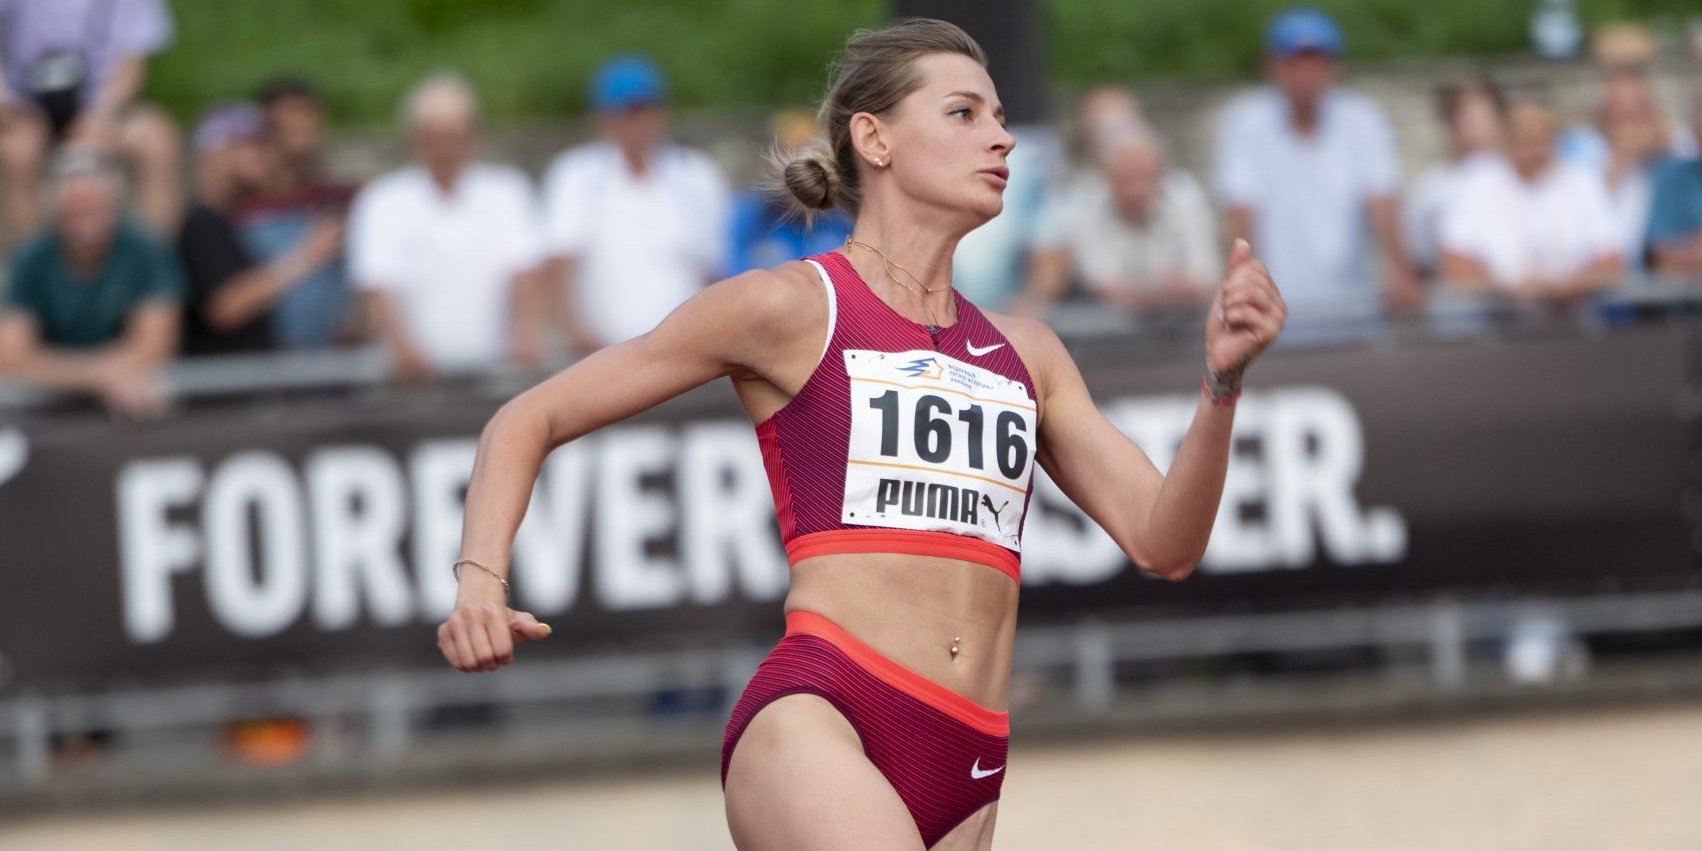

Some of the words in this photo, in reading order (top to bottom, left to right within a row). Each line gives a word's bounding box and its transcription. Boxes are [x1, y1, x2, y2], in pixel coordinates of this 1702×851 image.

[869, 389, 1028, 480] 1616
[116, 420, 789, 643] FOREVER
[876, 478, 979, 525] PUMA
